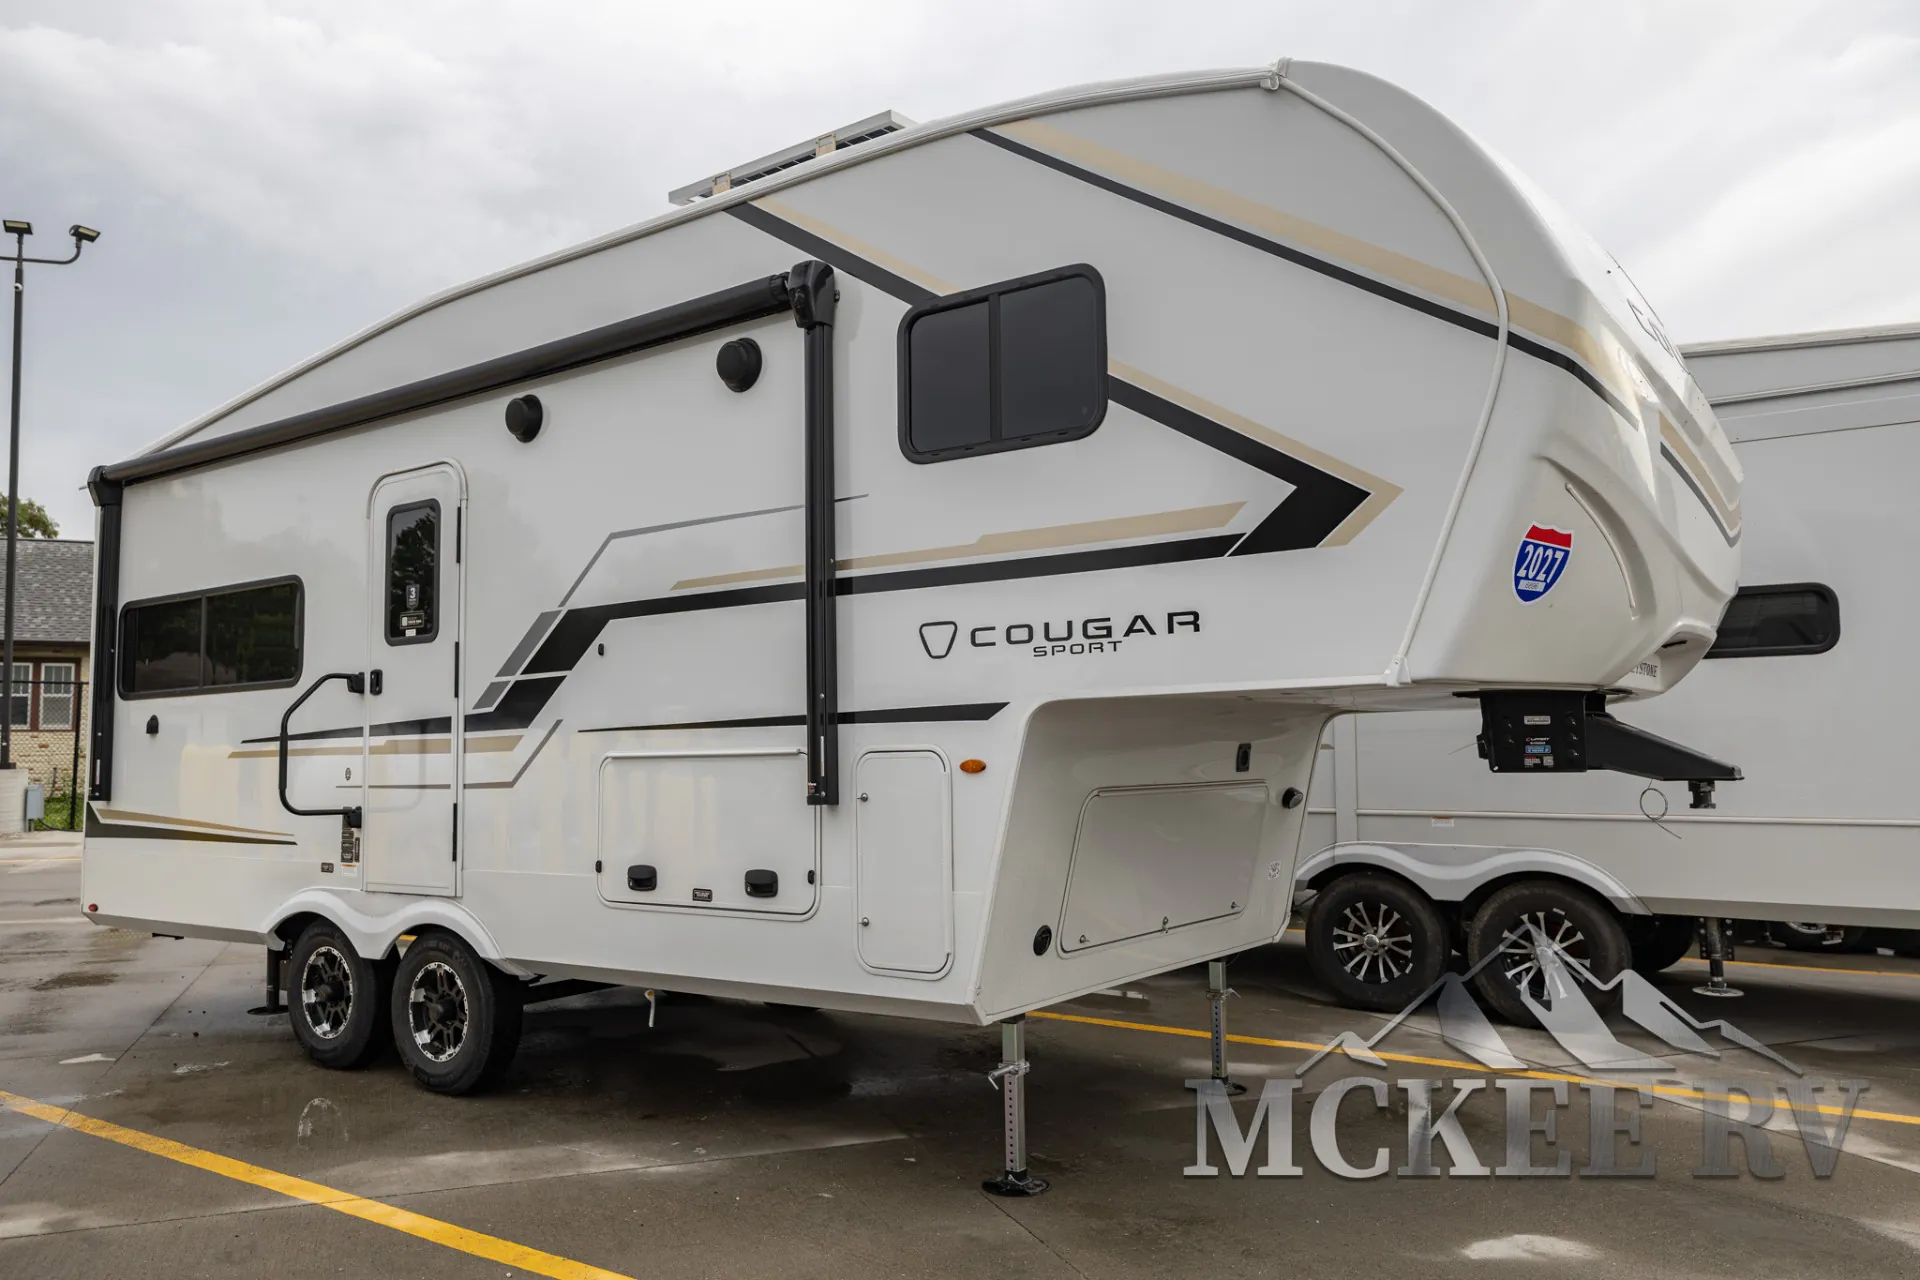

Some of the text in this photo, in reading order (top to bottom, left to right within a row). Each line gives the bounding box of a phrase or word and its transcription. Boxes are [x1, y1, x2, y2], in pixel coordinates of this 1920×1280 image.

[1516, 544, 1565, 583] 2027
[969, 610, 1201, 648] COUGAR
[1032, 640, 1123, 657] SPORT
